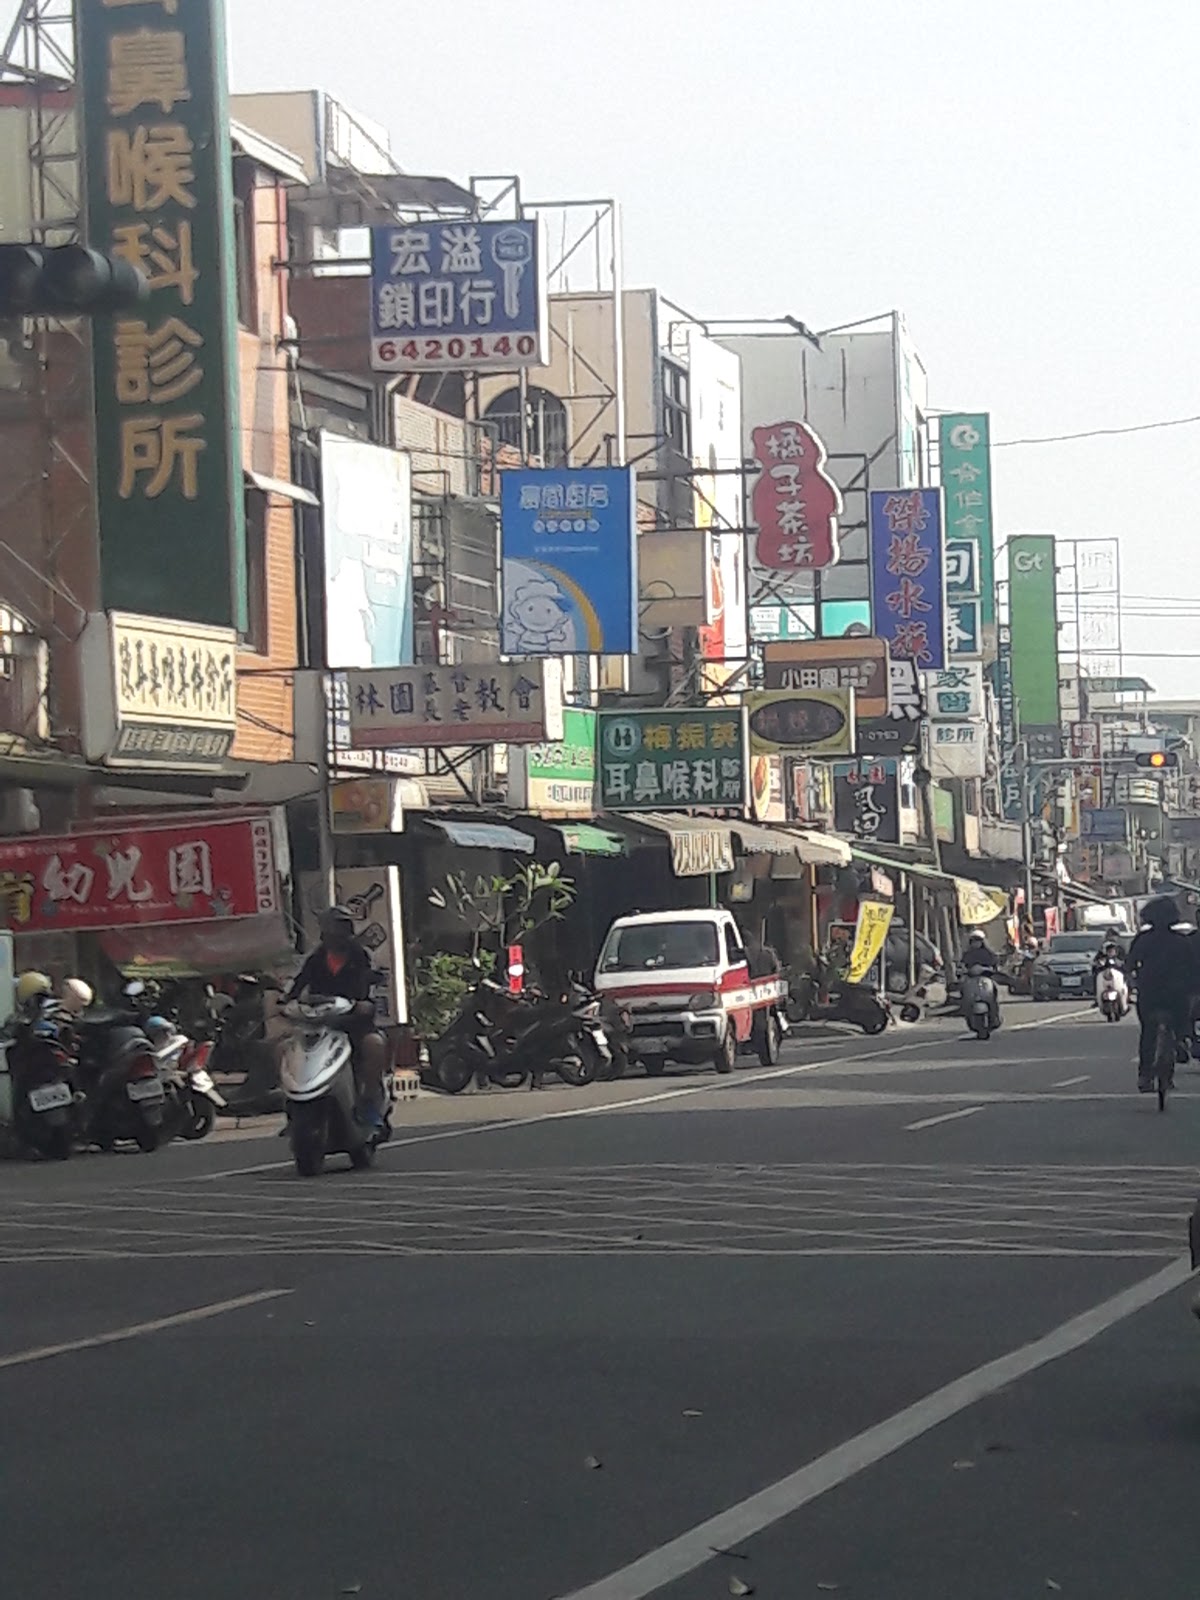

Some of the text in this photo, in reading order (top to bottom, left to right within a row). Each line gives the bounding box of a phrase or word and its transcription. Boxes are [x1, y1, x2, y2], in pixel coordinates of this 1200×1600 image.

[105, 0, 206, 500] 鼻喉科診所
[390, 226, 483, 275] 宏溢
[378, 279, 496, 330] 鎖印行
[378, 336, 535, 362] 6420140
